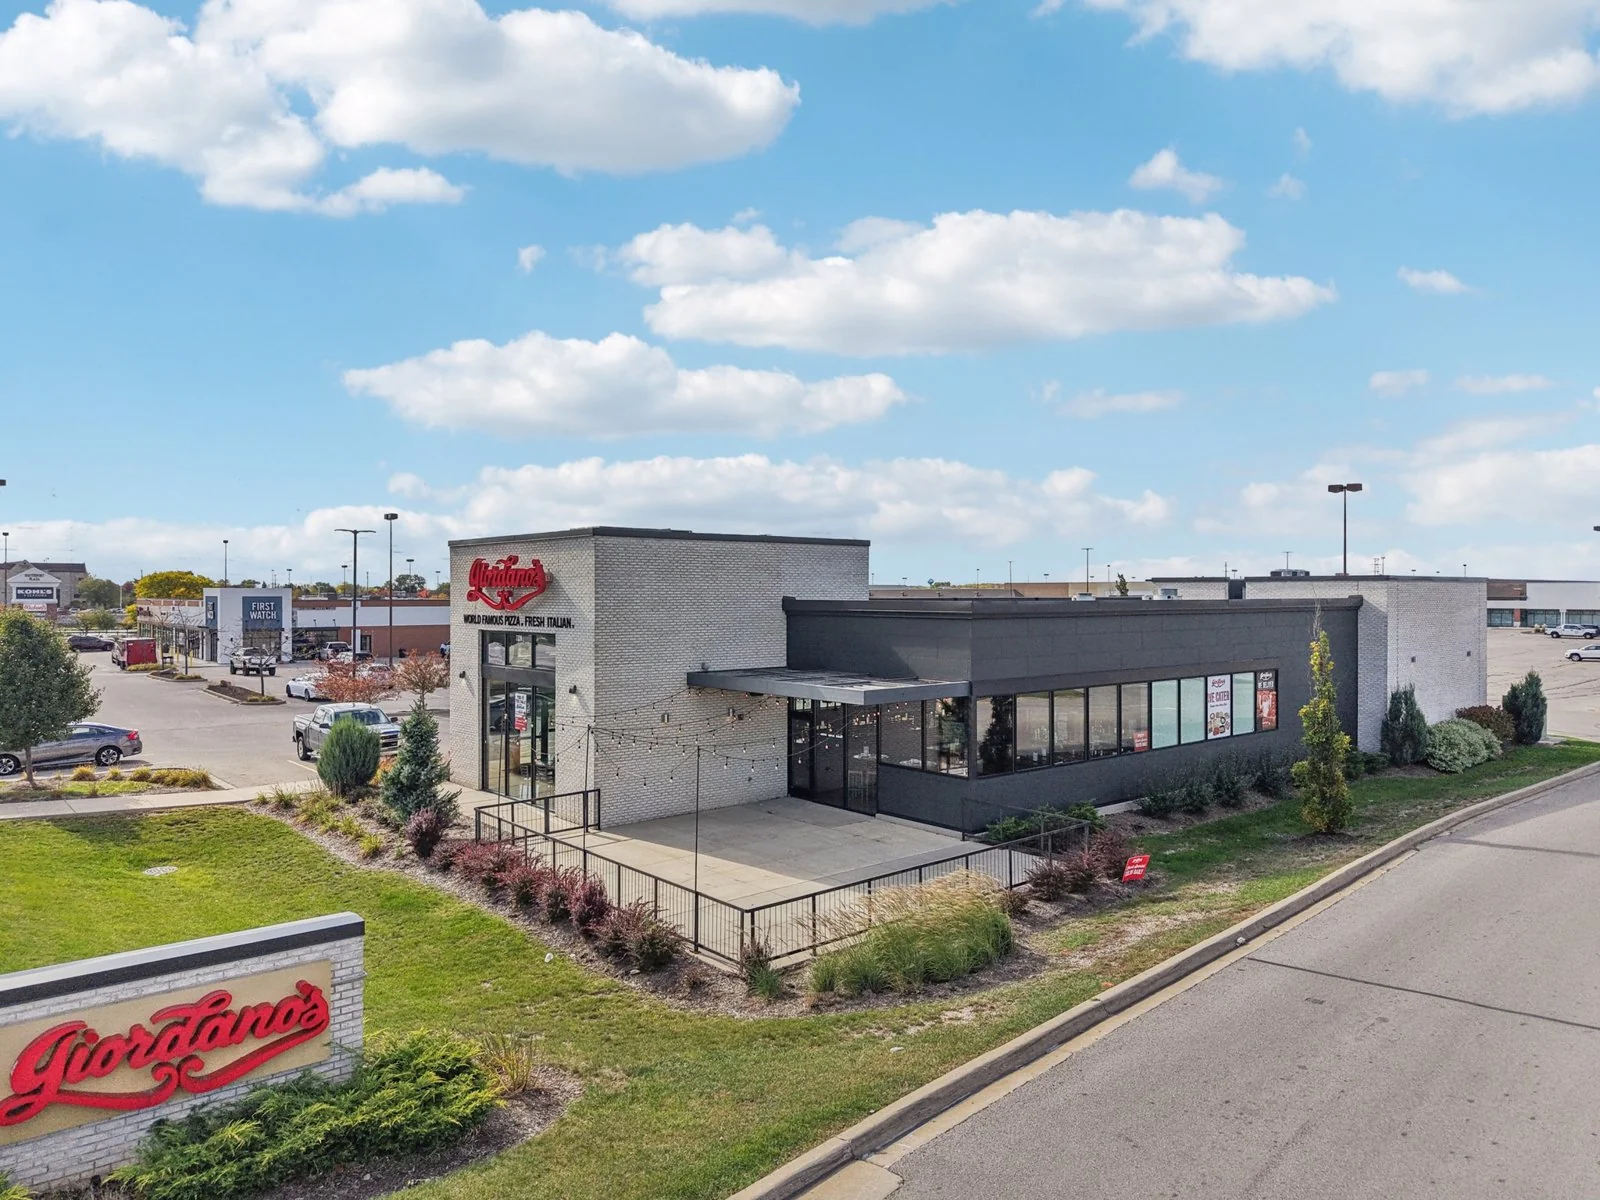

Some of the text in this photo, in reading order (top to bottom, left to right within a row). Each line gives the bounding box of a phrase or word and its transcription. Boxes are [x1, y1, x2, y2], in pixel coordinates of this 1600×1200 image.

[251, 602, 275, 611] FIRST
[249, 610, 277, 620] WATCH
[463, 614, 482, 625] WORLD
[482, 614, 504, 626] FAMOUS
[524, 616, 545, 628] FRESH
[1215, 690, 1230, 702] CATER
[0, 979, 330, 1127] Giordano's
